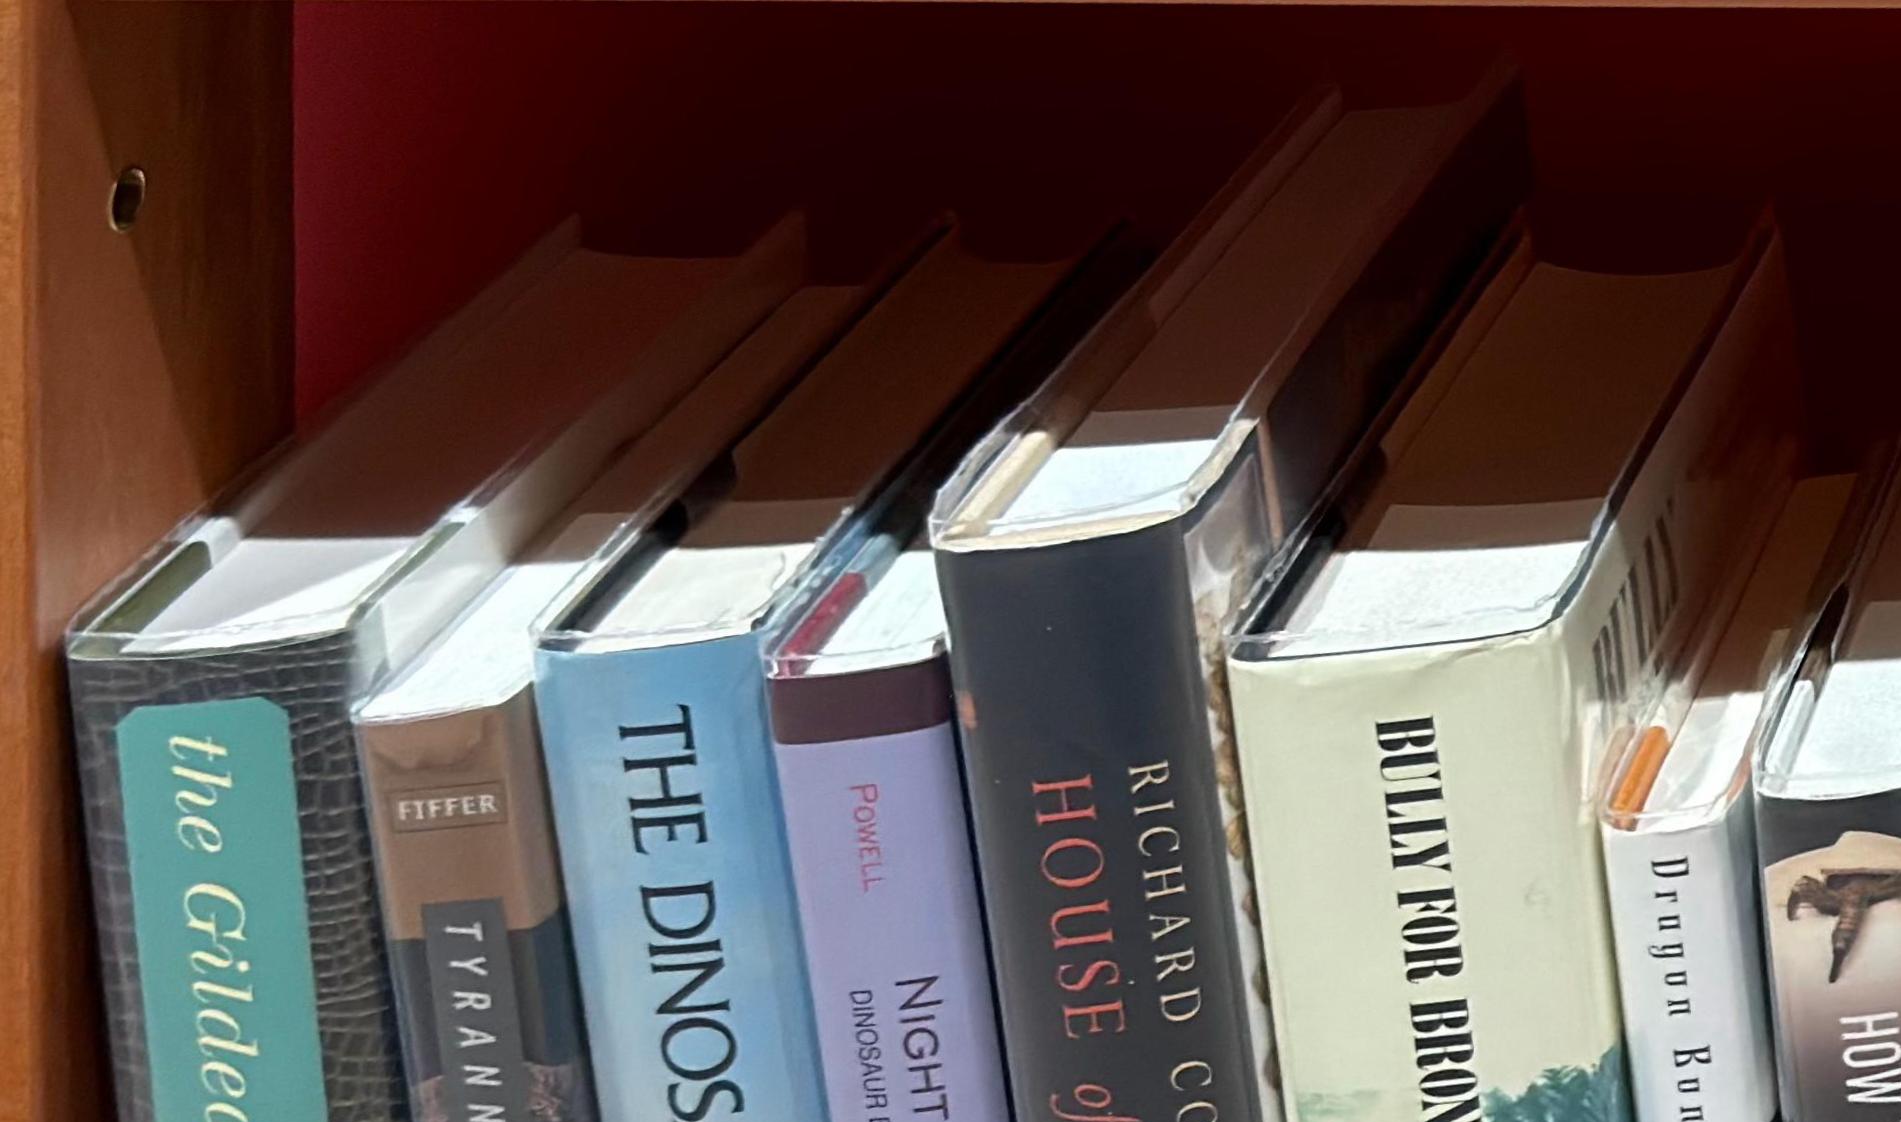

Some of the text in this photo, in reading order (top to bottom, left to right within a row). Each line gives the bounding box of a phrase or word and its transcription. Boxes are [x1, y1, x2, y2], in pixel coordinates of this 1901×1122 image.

[168, 735, 231, 854] the
[398, 793, 499, 823] FIFFER
[618, 704, 709, 856] THE
[848, 783, 887, 893] POWELL
[1375, 715, 1453, 873] BULLY
[1031, 773, 1127, 1041] HOUSE
[1127, 759, 1204, 1024] RICHARD
[1396, 886, 1464, 986] FOR
[1649, 856, 1692, 1017] Dragon
[849, 988, 889, 1111] DINOSAUR
[894, 974, 951, 1122] NIGHT
